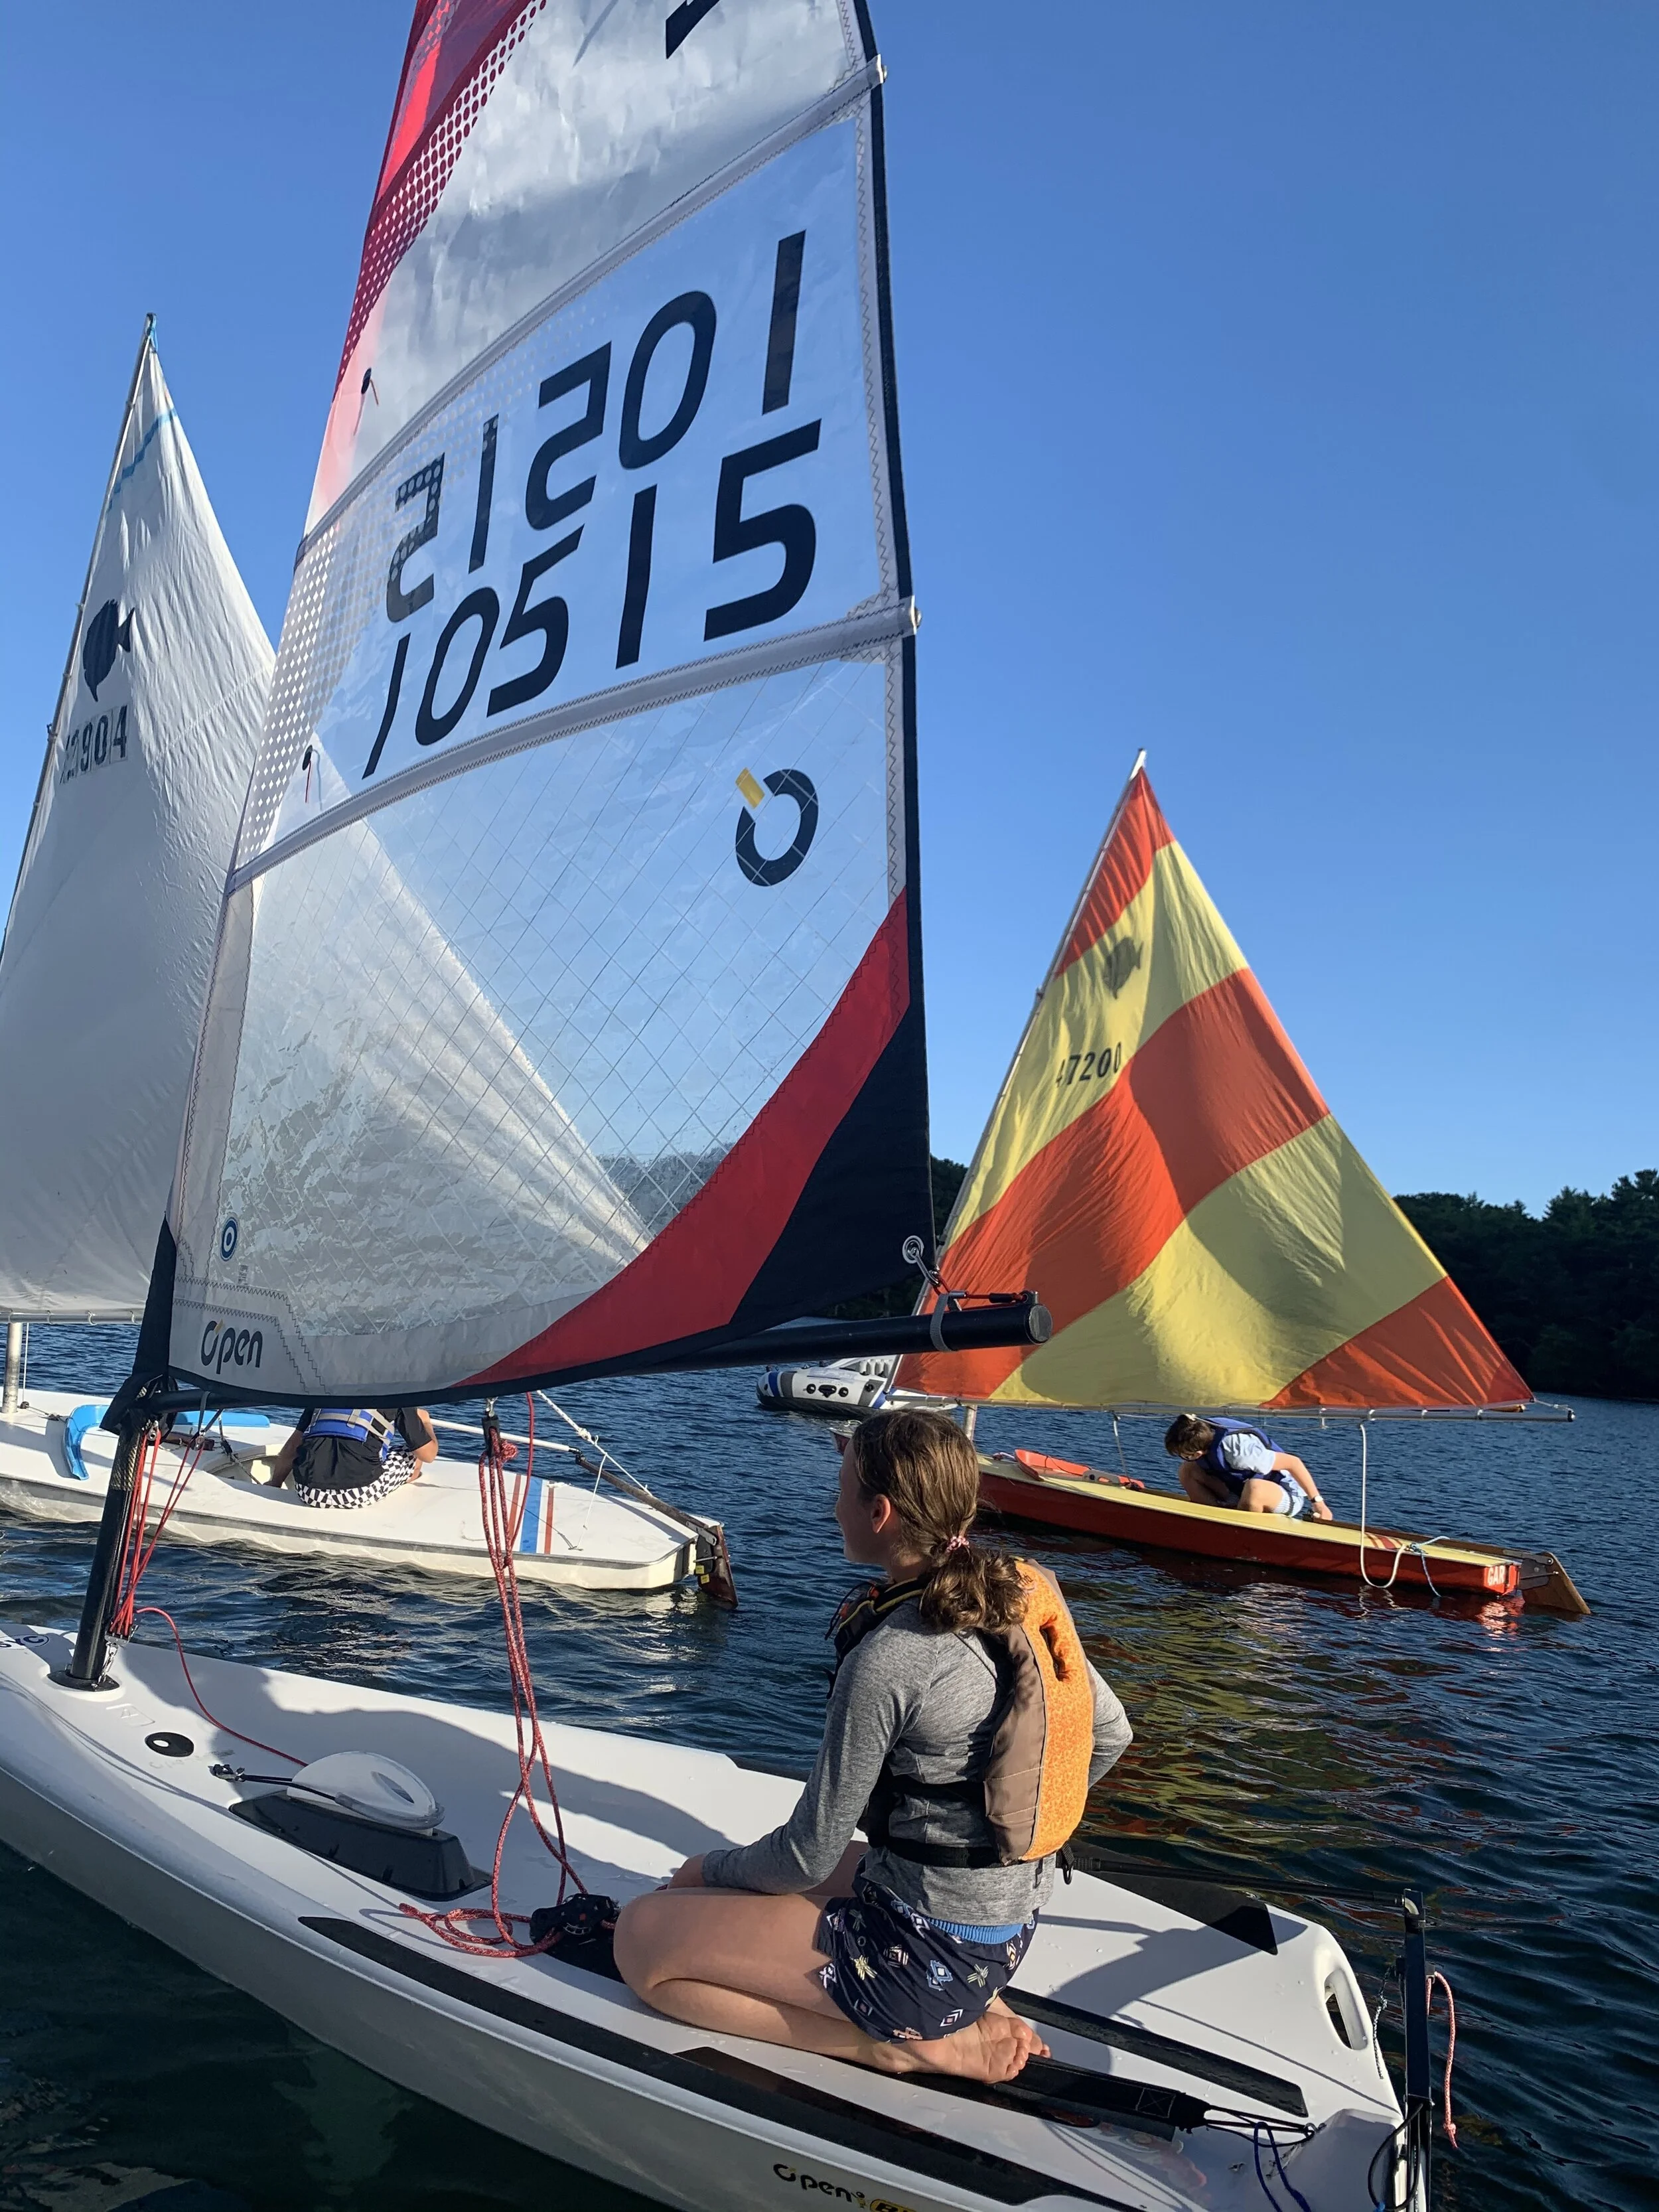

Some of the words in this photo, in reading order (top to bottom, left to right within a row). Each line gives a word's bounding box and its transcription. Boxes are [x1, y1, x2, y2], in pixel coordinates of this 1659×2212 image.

[362, 419, 822, 779] 10515
[200, 1319, 263, 1374] Open
[773, 2164, 852, 2203] Open
